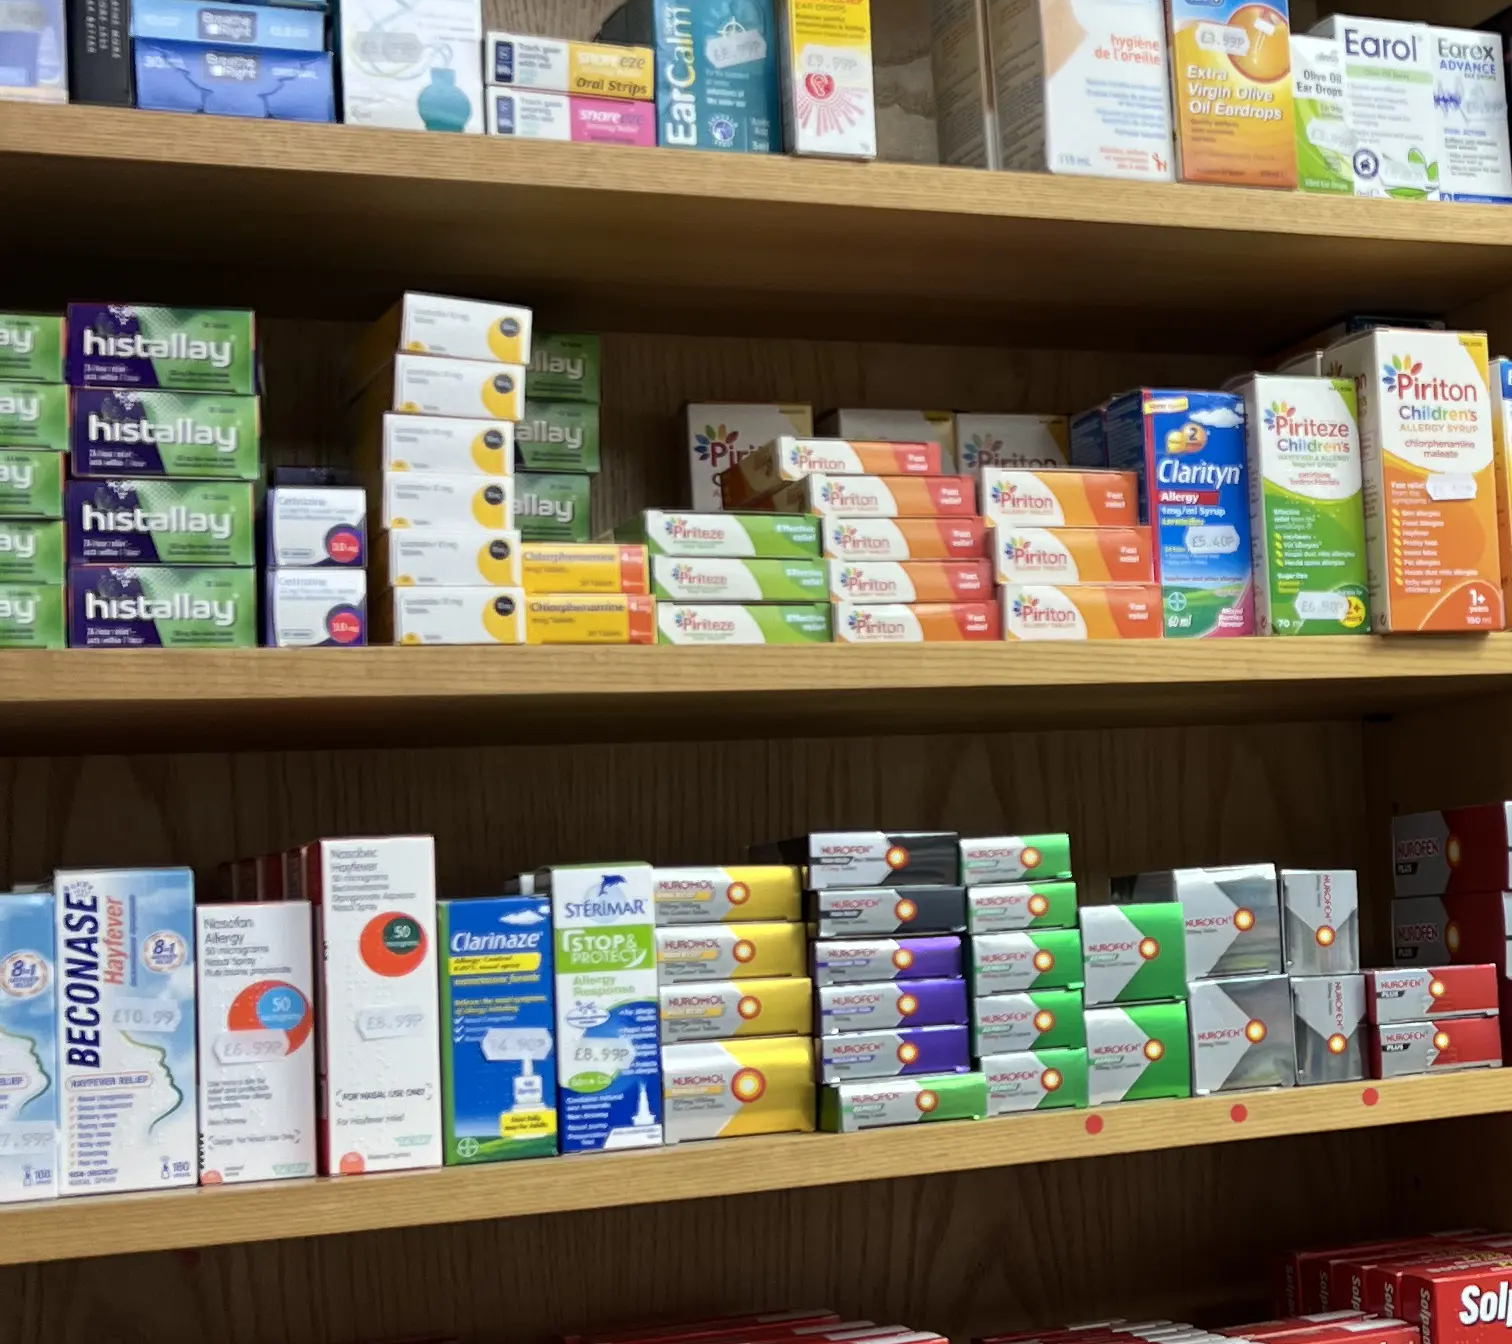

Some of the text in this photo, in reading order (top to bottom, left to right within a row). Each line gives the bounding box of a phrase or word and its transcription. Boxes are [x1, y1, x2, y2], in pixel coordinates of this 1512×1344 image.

[1344, 29, 1418, 62] Earol
[1438, 40, 1494, 62] Earex
[1187, 65, 1228, 81] Extra
[1440, 60, 1496, 76] ADVANCE
[576, 78, 647, 95] Oral Strips
[1187, 83, 1274, 103] Virgin Olive
[1189, 99, 1282, 123] Oil Eardrops
[1397, 373, 1477, 405] Piriton
[1398, 405, 1478, 423] Children's
[1275, 416, 1349, 440] Piriteze
[1399, 423, 1478, 434] ALLERGY SYRUP
[1159, 458, 1241, 490] Clarityn
[82, 503, 232, 539] histallay
[85, 591, 235, 627] histallay
[1021, 607, 1076, 627] Piriton
[104, 895, 125, 985] Hayfever
[204, 931, 244, 946] Allergy
[452, 929, 539, 952] Clarinaze
[63, 892, 101, 1069] BECONASE
[573, 974, 616, 988] Allergy
[573, 983, 635, 997] Response
